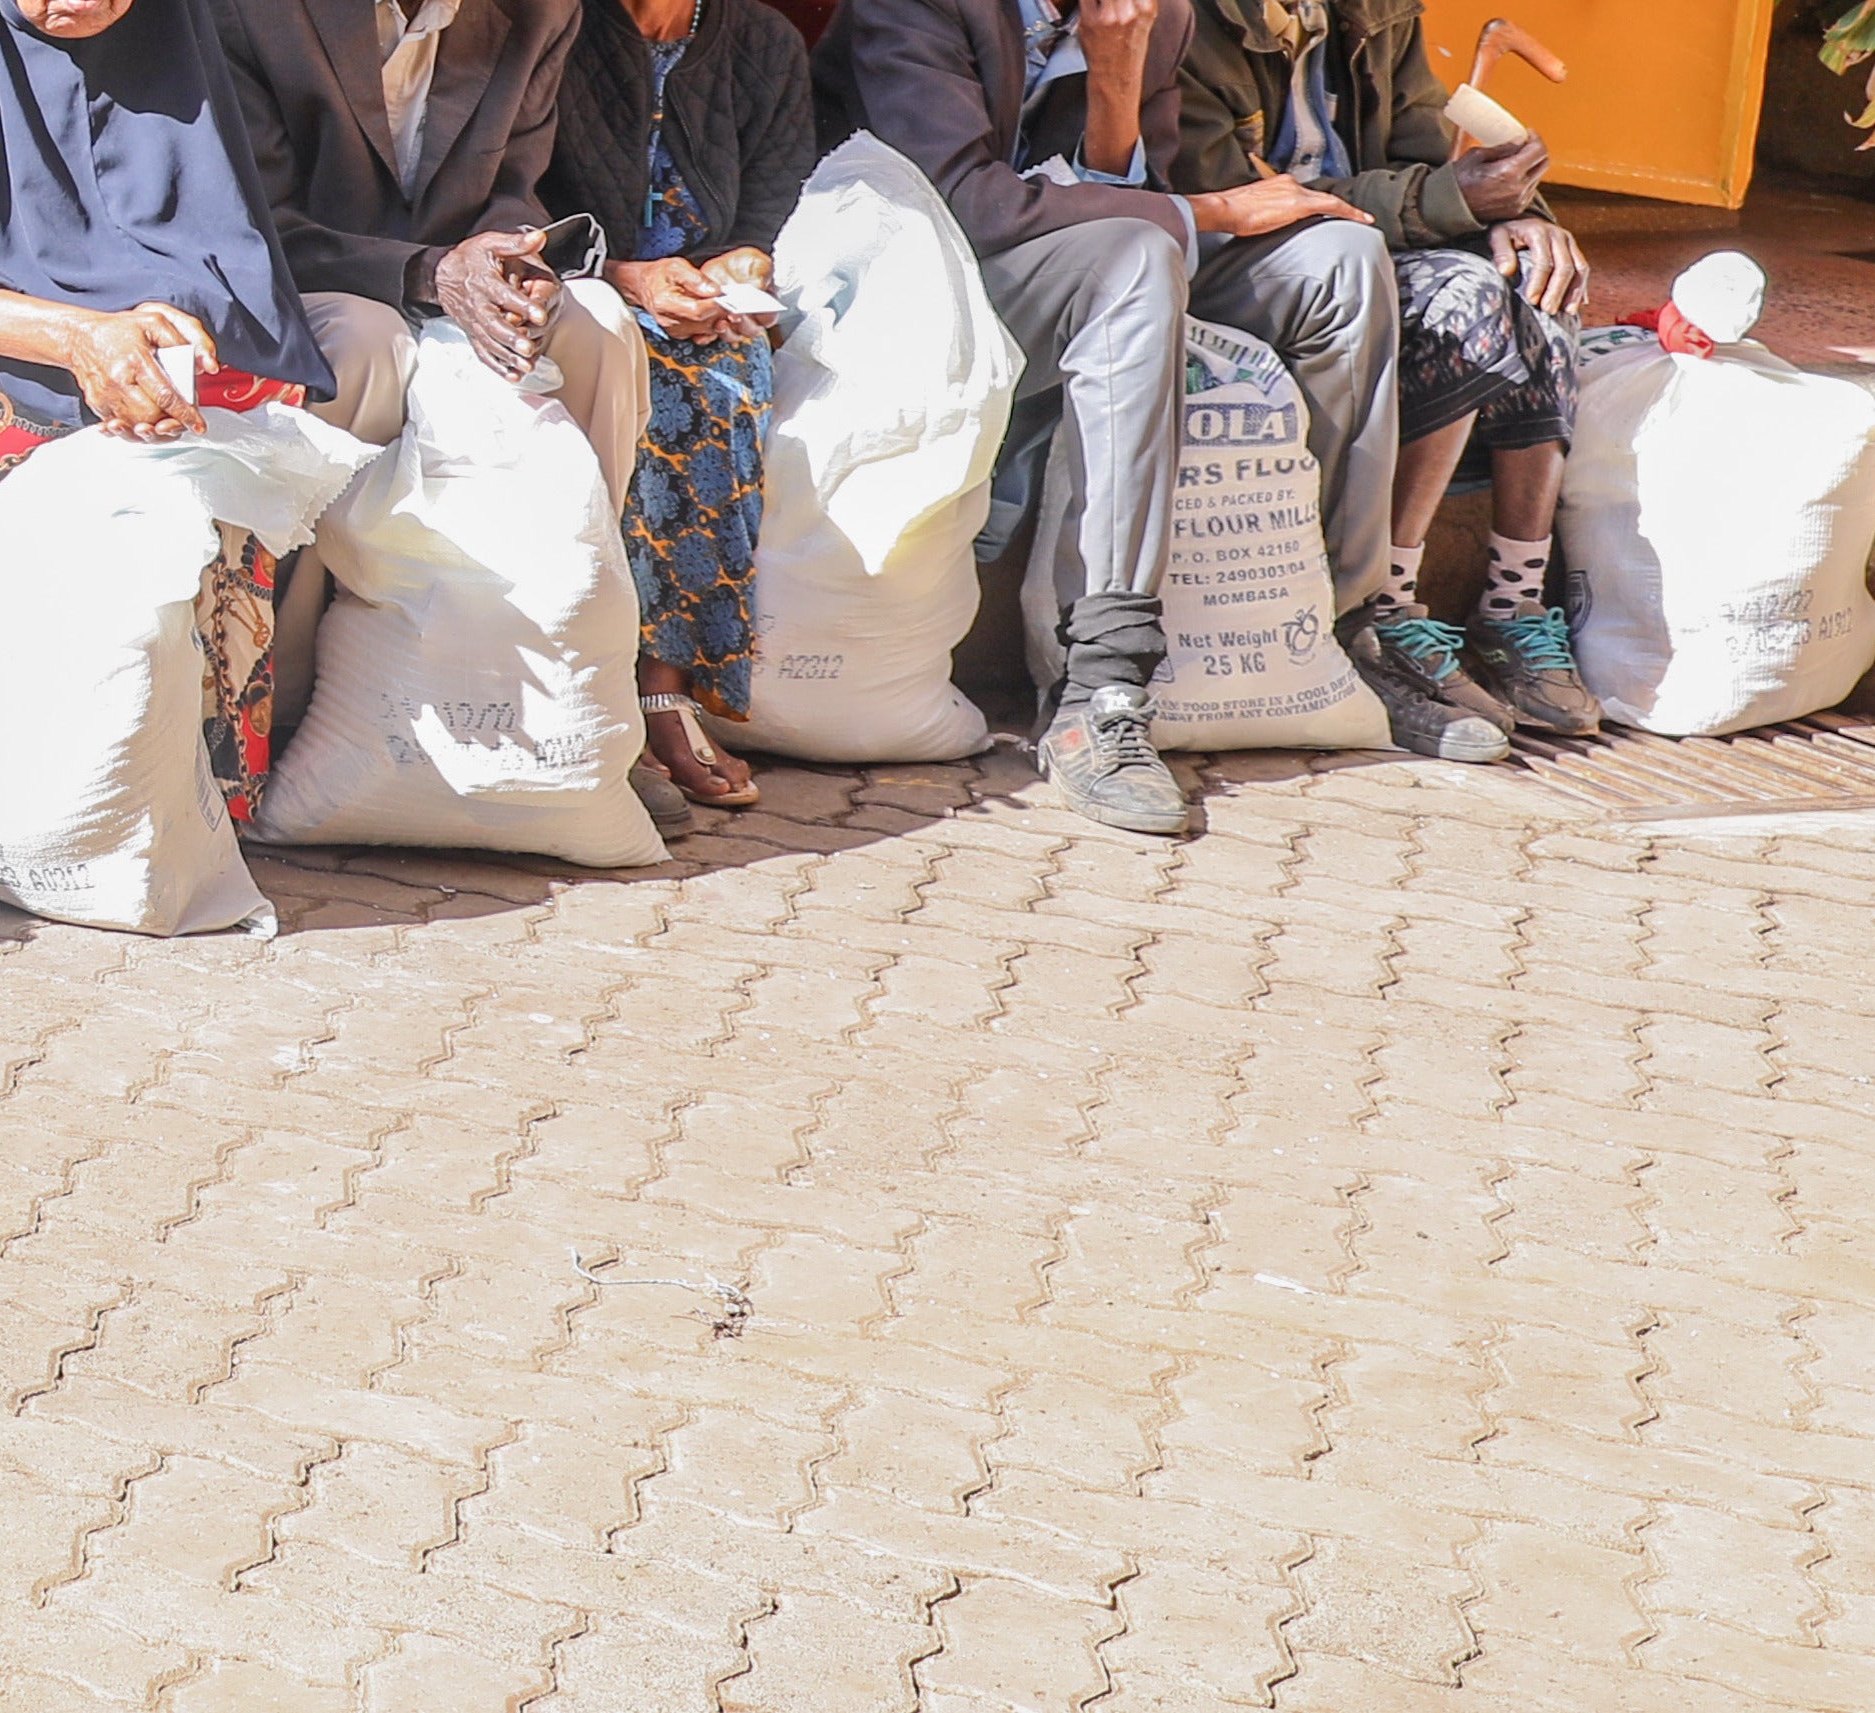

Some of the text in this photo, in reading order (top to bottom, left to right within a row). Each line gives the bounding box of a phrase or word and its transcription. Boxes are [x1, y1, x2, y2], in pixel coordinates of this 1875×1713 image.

[1179, 462, 1224, 488] RS
[1175, 499, 1203, 511] CED
[1207, 495, 1216, 508] &
[1221, 492, 1273, 507] PACKED
[1173, 513, 1262, 539] FLOUR
[1216, 547, 1251, 562] BOX
[1257, 540, 1299, 557] 42160
[1169, 573, 1210, 585] TEL:
[1203, 587, 1290, 606] MOMBASA
[1178, 628, 1279, 648] Net Weight
[1203, 651, 1266, 676] 25 KG
[1183, 676, 1350, 712] FOOD STORE IN A COOL DRY
[1197, 711, 1234, 722] FROM
[1239, 708, 1262, 719] ANY
[1266, 681, 1358, 717] CONTAMINATION
